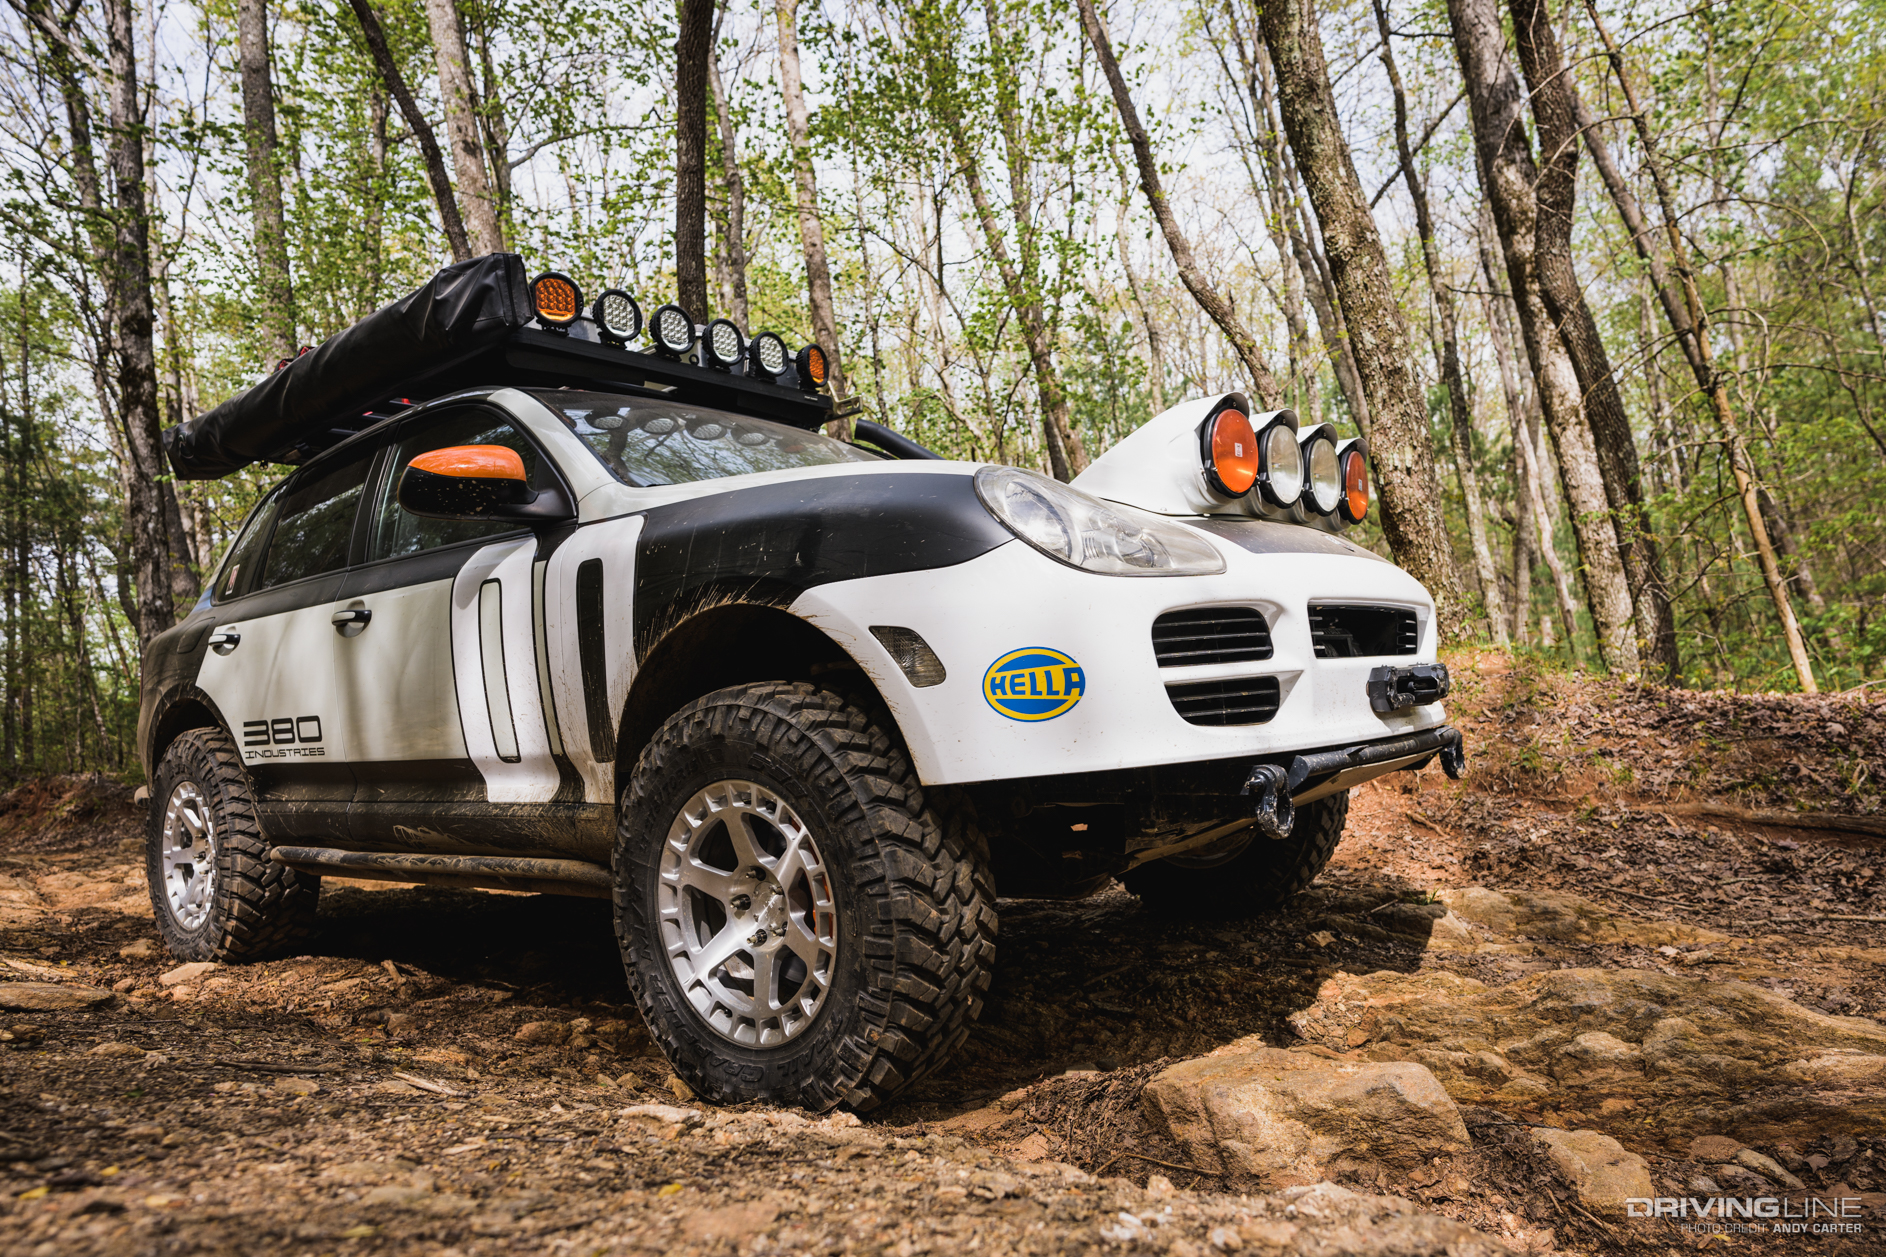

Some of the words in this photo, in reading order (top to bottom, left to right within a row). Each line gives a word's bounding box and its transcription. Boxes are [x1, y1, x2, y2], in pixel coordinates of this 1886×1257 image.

[989, 666, 1085, 696] HELLA
[243, 715, 322, 746] 380
[244, 747, 325, 759] INDUSTRIES
[646, 970, 766, 1084] GRAPPLER
